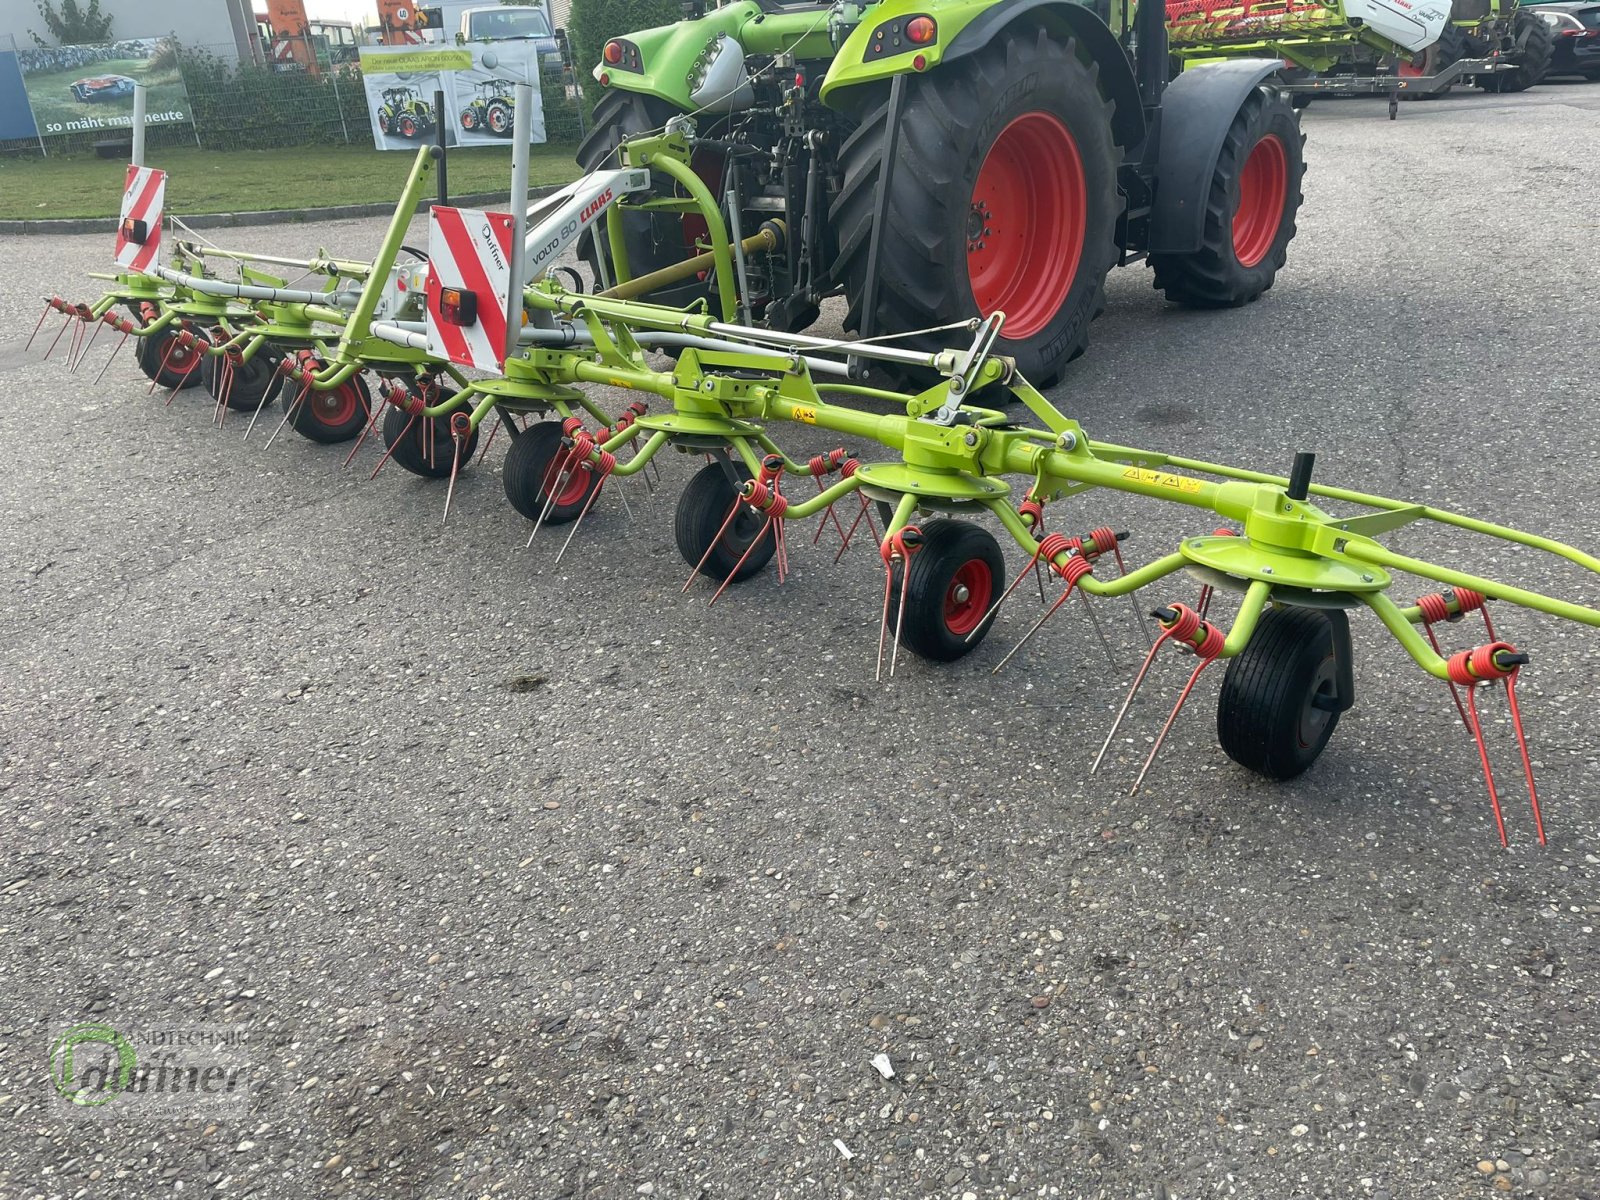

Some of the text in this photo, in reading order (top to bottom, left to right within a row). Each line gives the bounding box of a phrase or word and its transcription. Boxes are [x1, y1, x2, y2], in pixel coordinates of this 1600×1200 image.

[1419, 10, 1434, 21] VARIO
[1429, 8, 1445, 20] 770
[46, 122, 62, 132] so
[66, 116, 105, 131] mäht
[532, 187, 613, 265] VOLTO 80 CLAAS
[481, 223, 504, 271] Duffner
